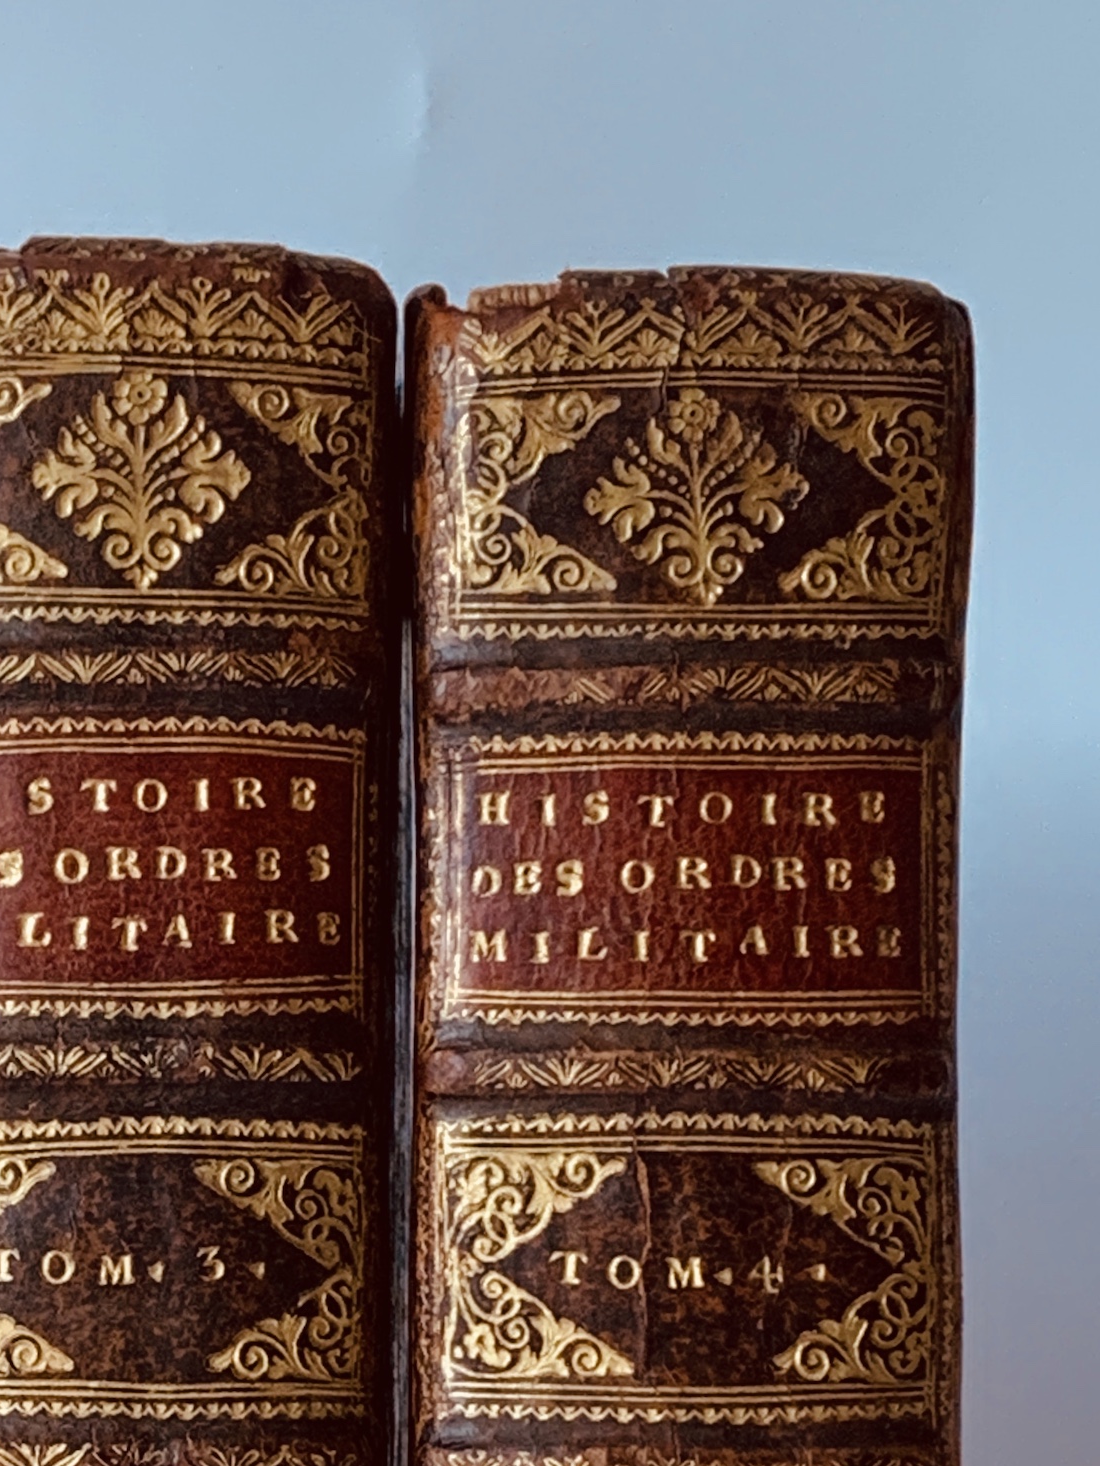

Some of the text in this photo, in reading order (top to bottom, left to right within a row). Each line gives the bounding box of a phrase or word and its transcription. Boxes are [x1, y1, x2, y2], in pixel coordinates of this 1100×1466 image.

[479, 790, 885, 828] HISTOIRE
[54, 844, 331, 884] ORDRES
[472, 854, 896, 898] DES ORDRES
[470, 924, 901, 964] MILITAIRE
